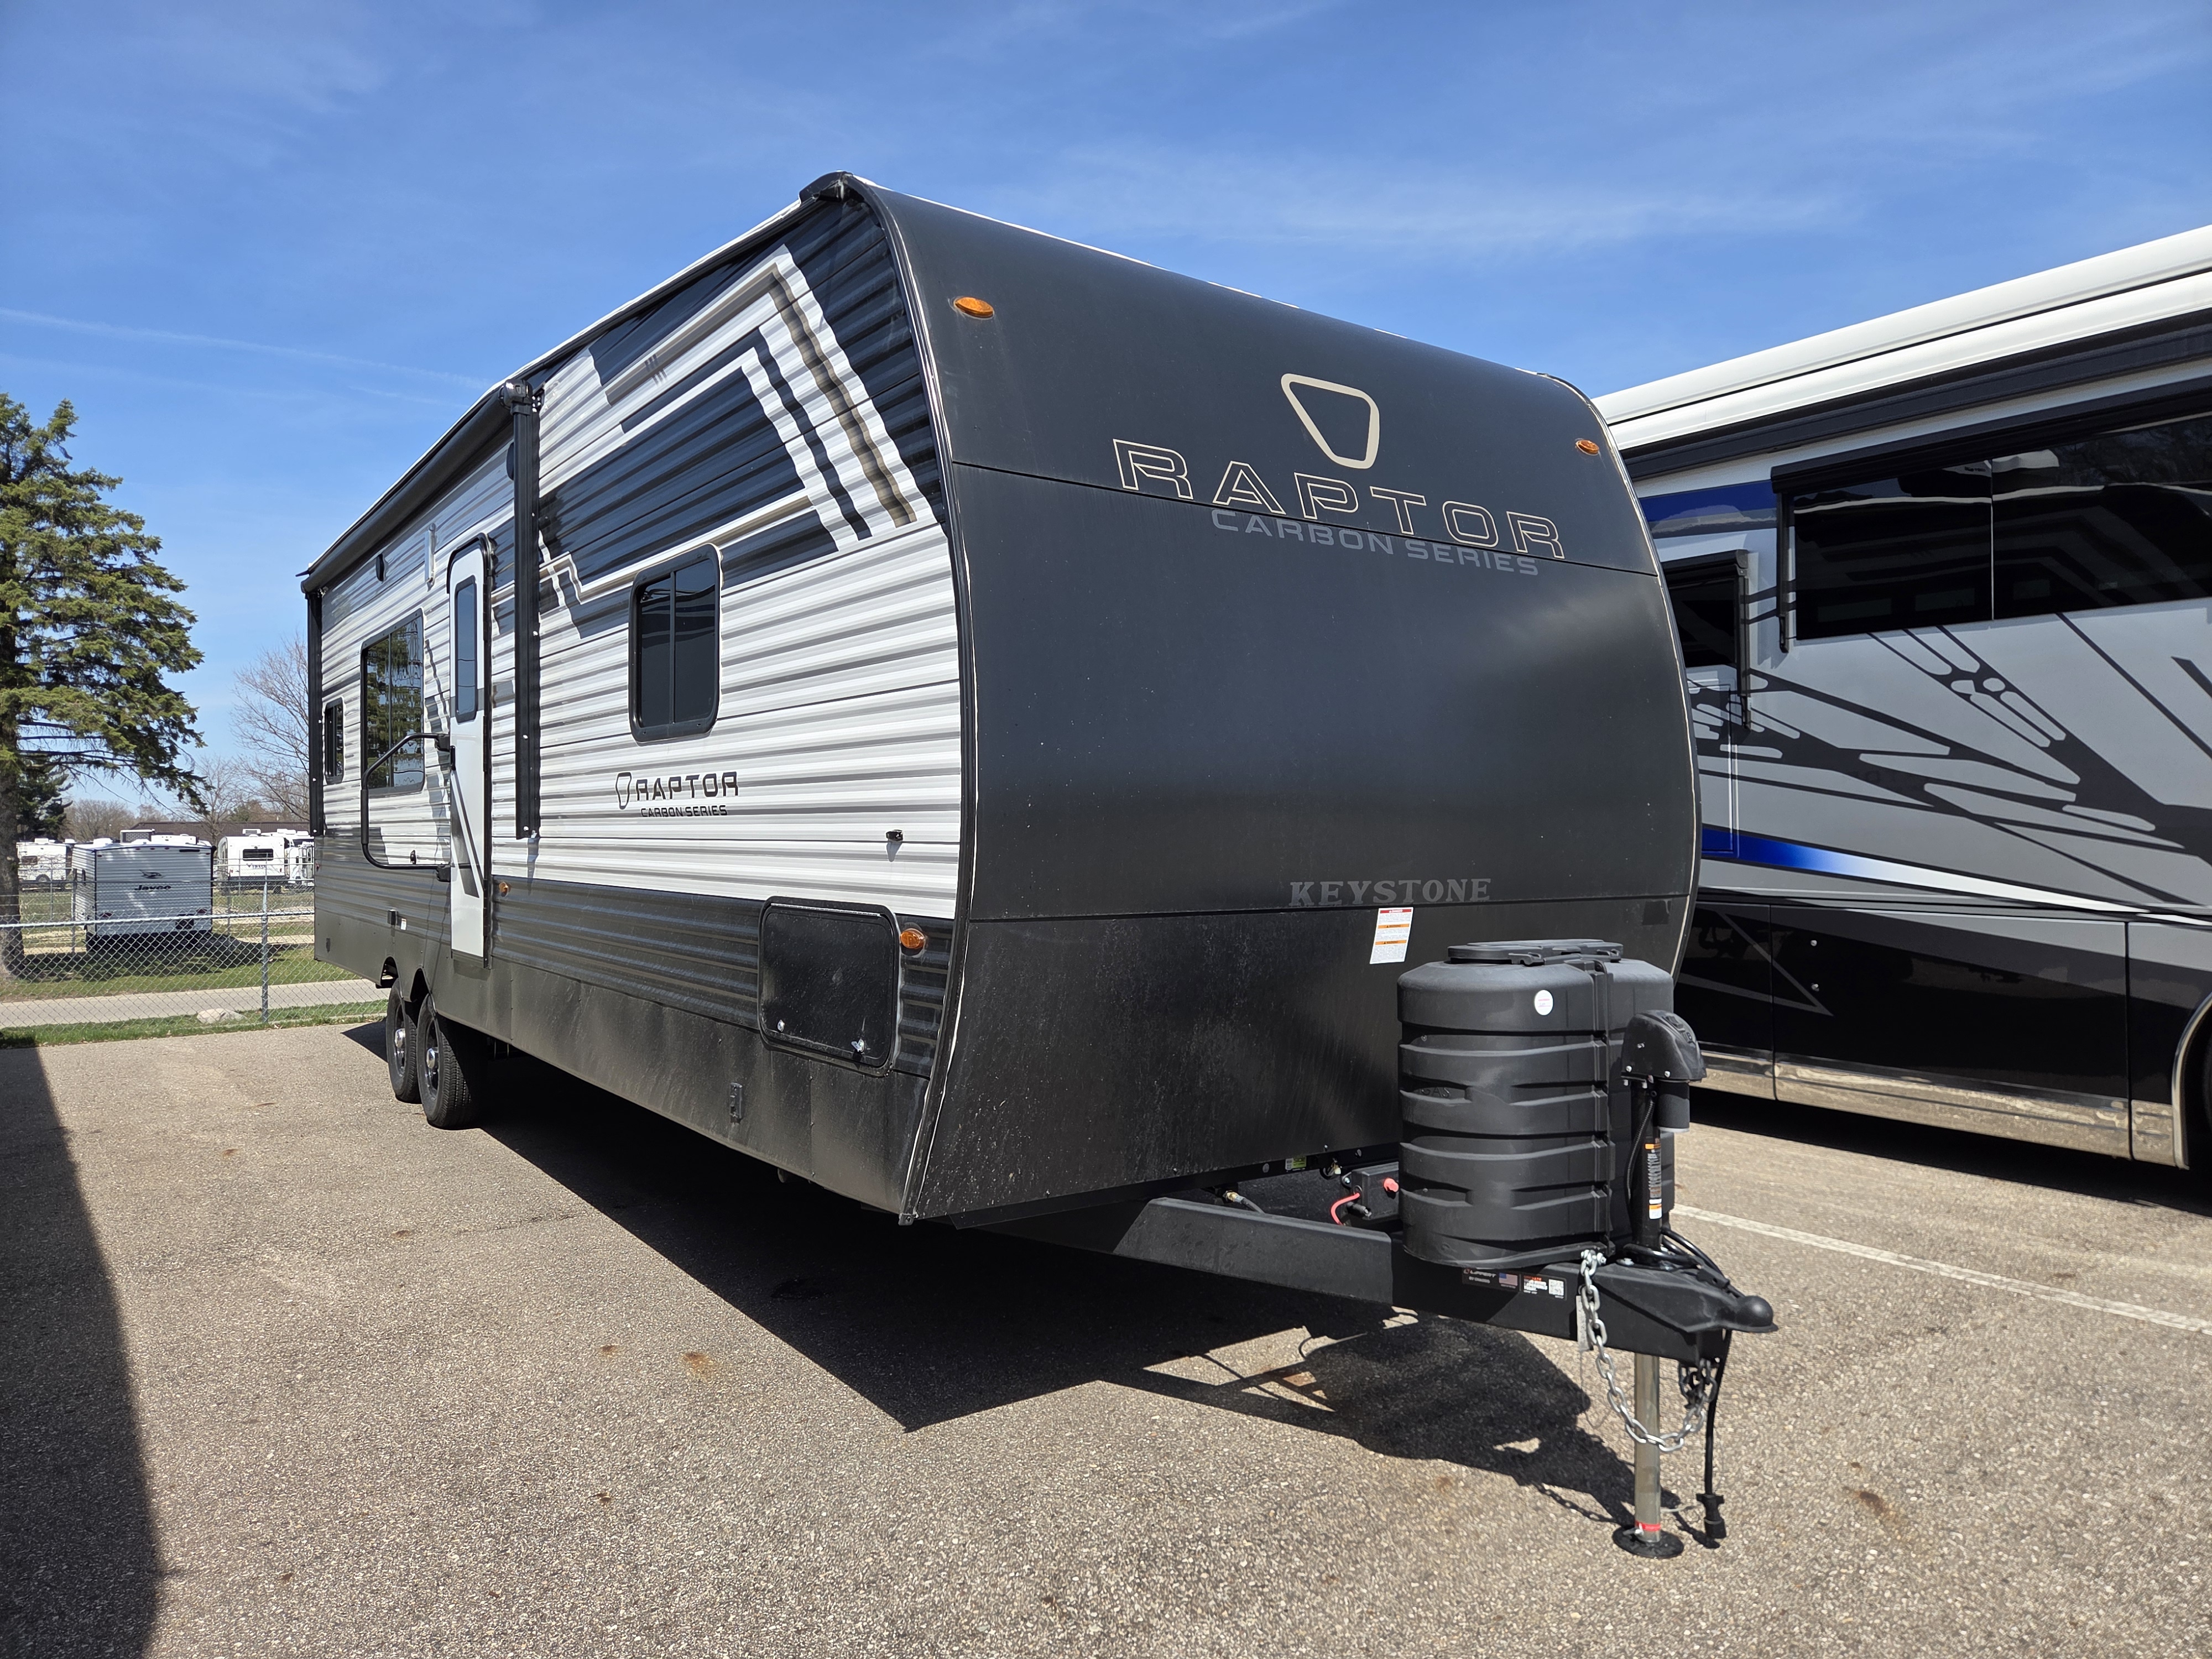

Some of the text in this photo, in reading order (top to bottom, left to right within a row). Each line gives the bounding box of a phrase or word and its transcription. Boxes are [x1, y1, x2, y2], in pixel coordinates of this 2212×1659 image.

[1112, 439, 1565, 559] RAPTOR
[1211, 508, 1538, 576] CARBON SERIES
[635, 771, 738, 801] RAPTOR
[640, 805, 728, 817] CARBON SERIES
[1288, 878, 1491, 907] KEYSTONE
